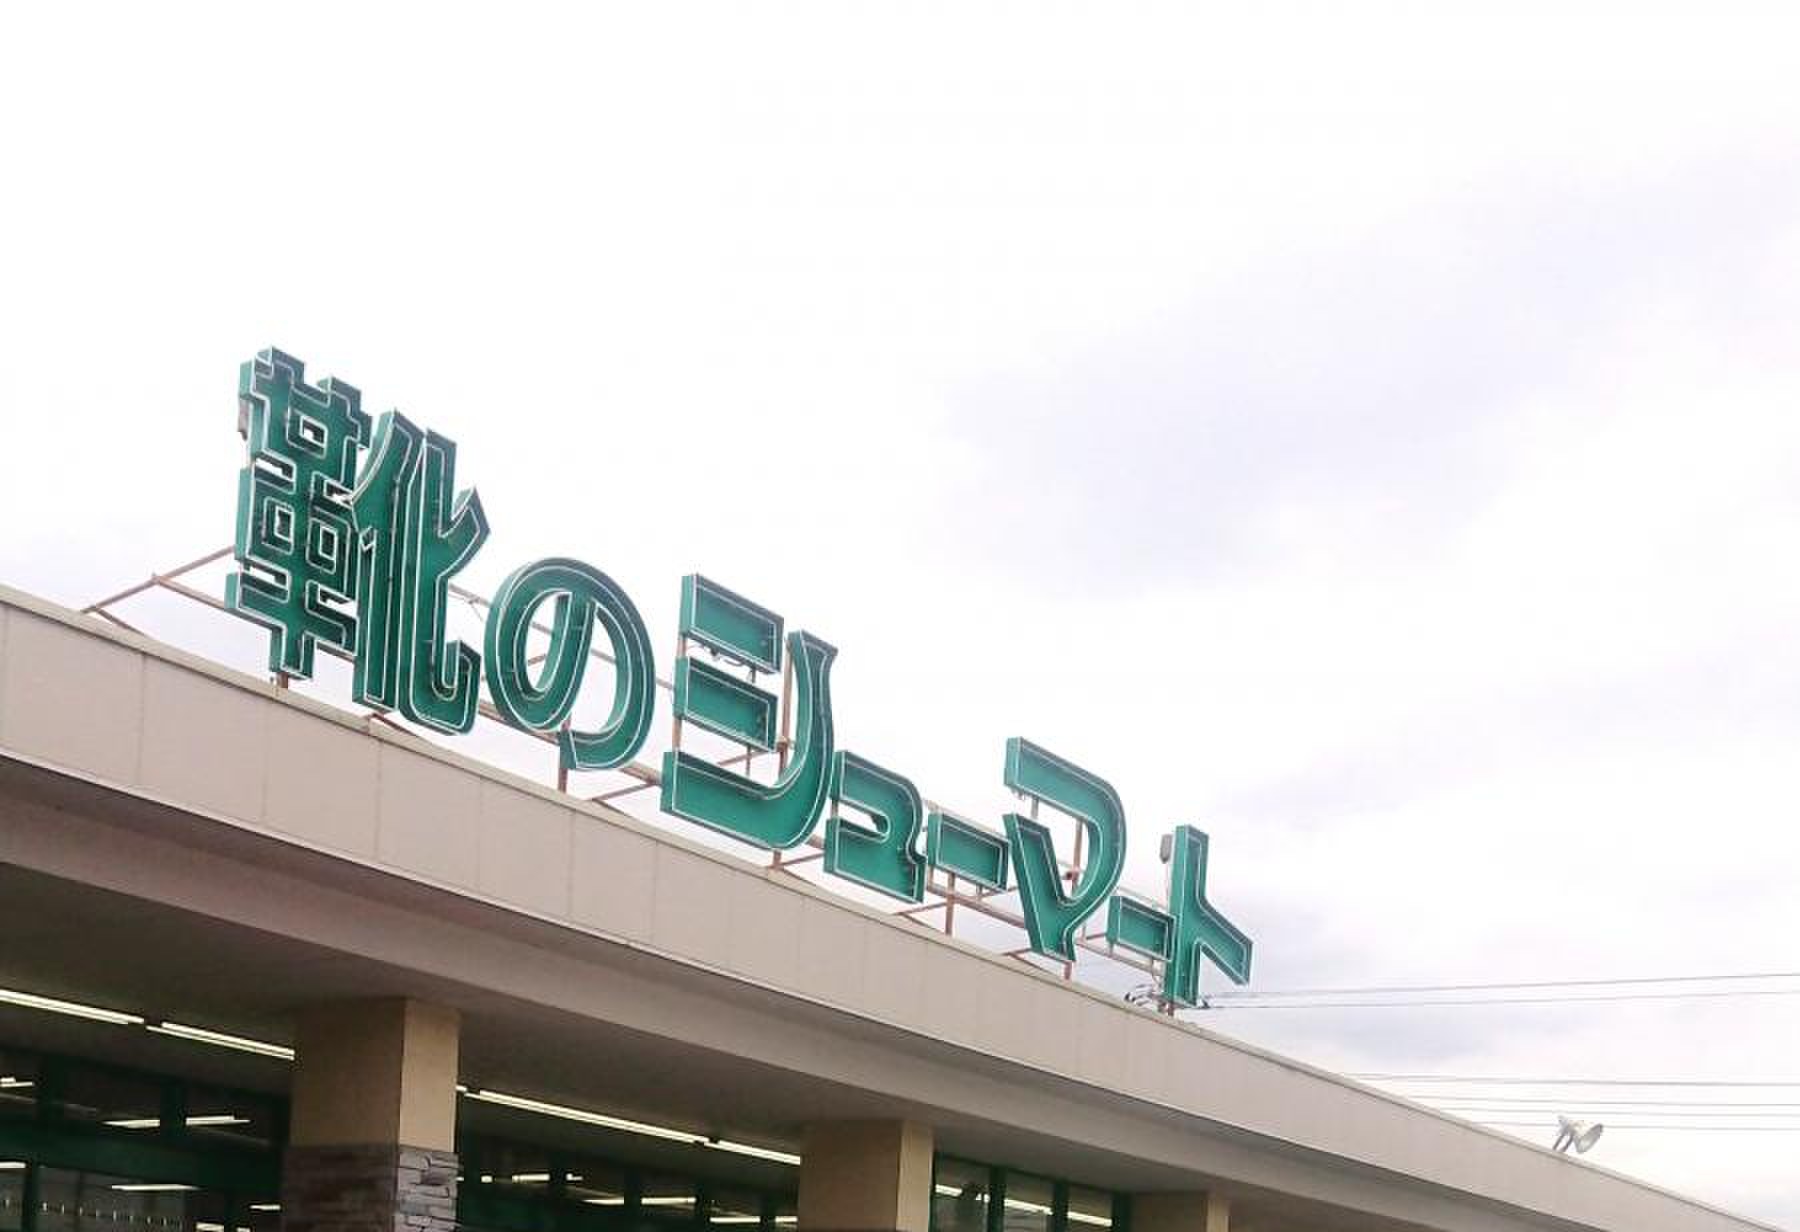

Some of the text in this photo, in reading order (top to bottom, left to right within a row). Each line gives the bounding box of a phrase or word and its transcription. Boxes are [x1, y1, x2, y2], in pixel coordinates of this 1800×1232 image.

[226, 347, 1252, 1007] 靴のシューマート
